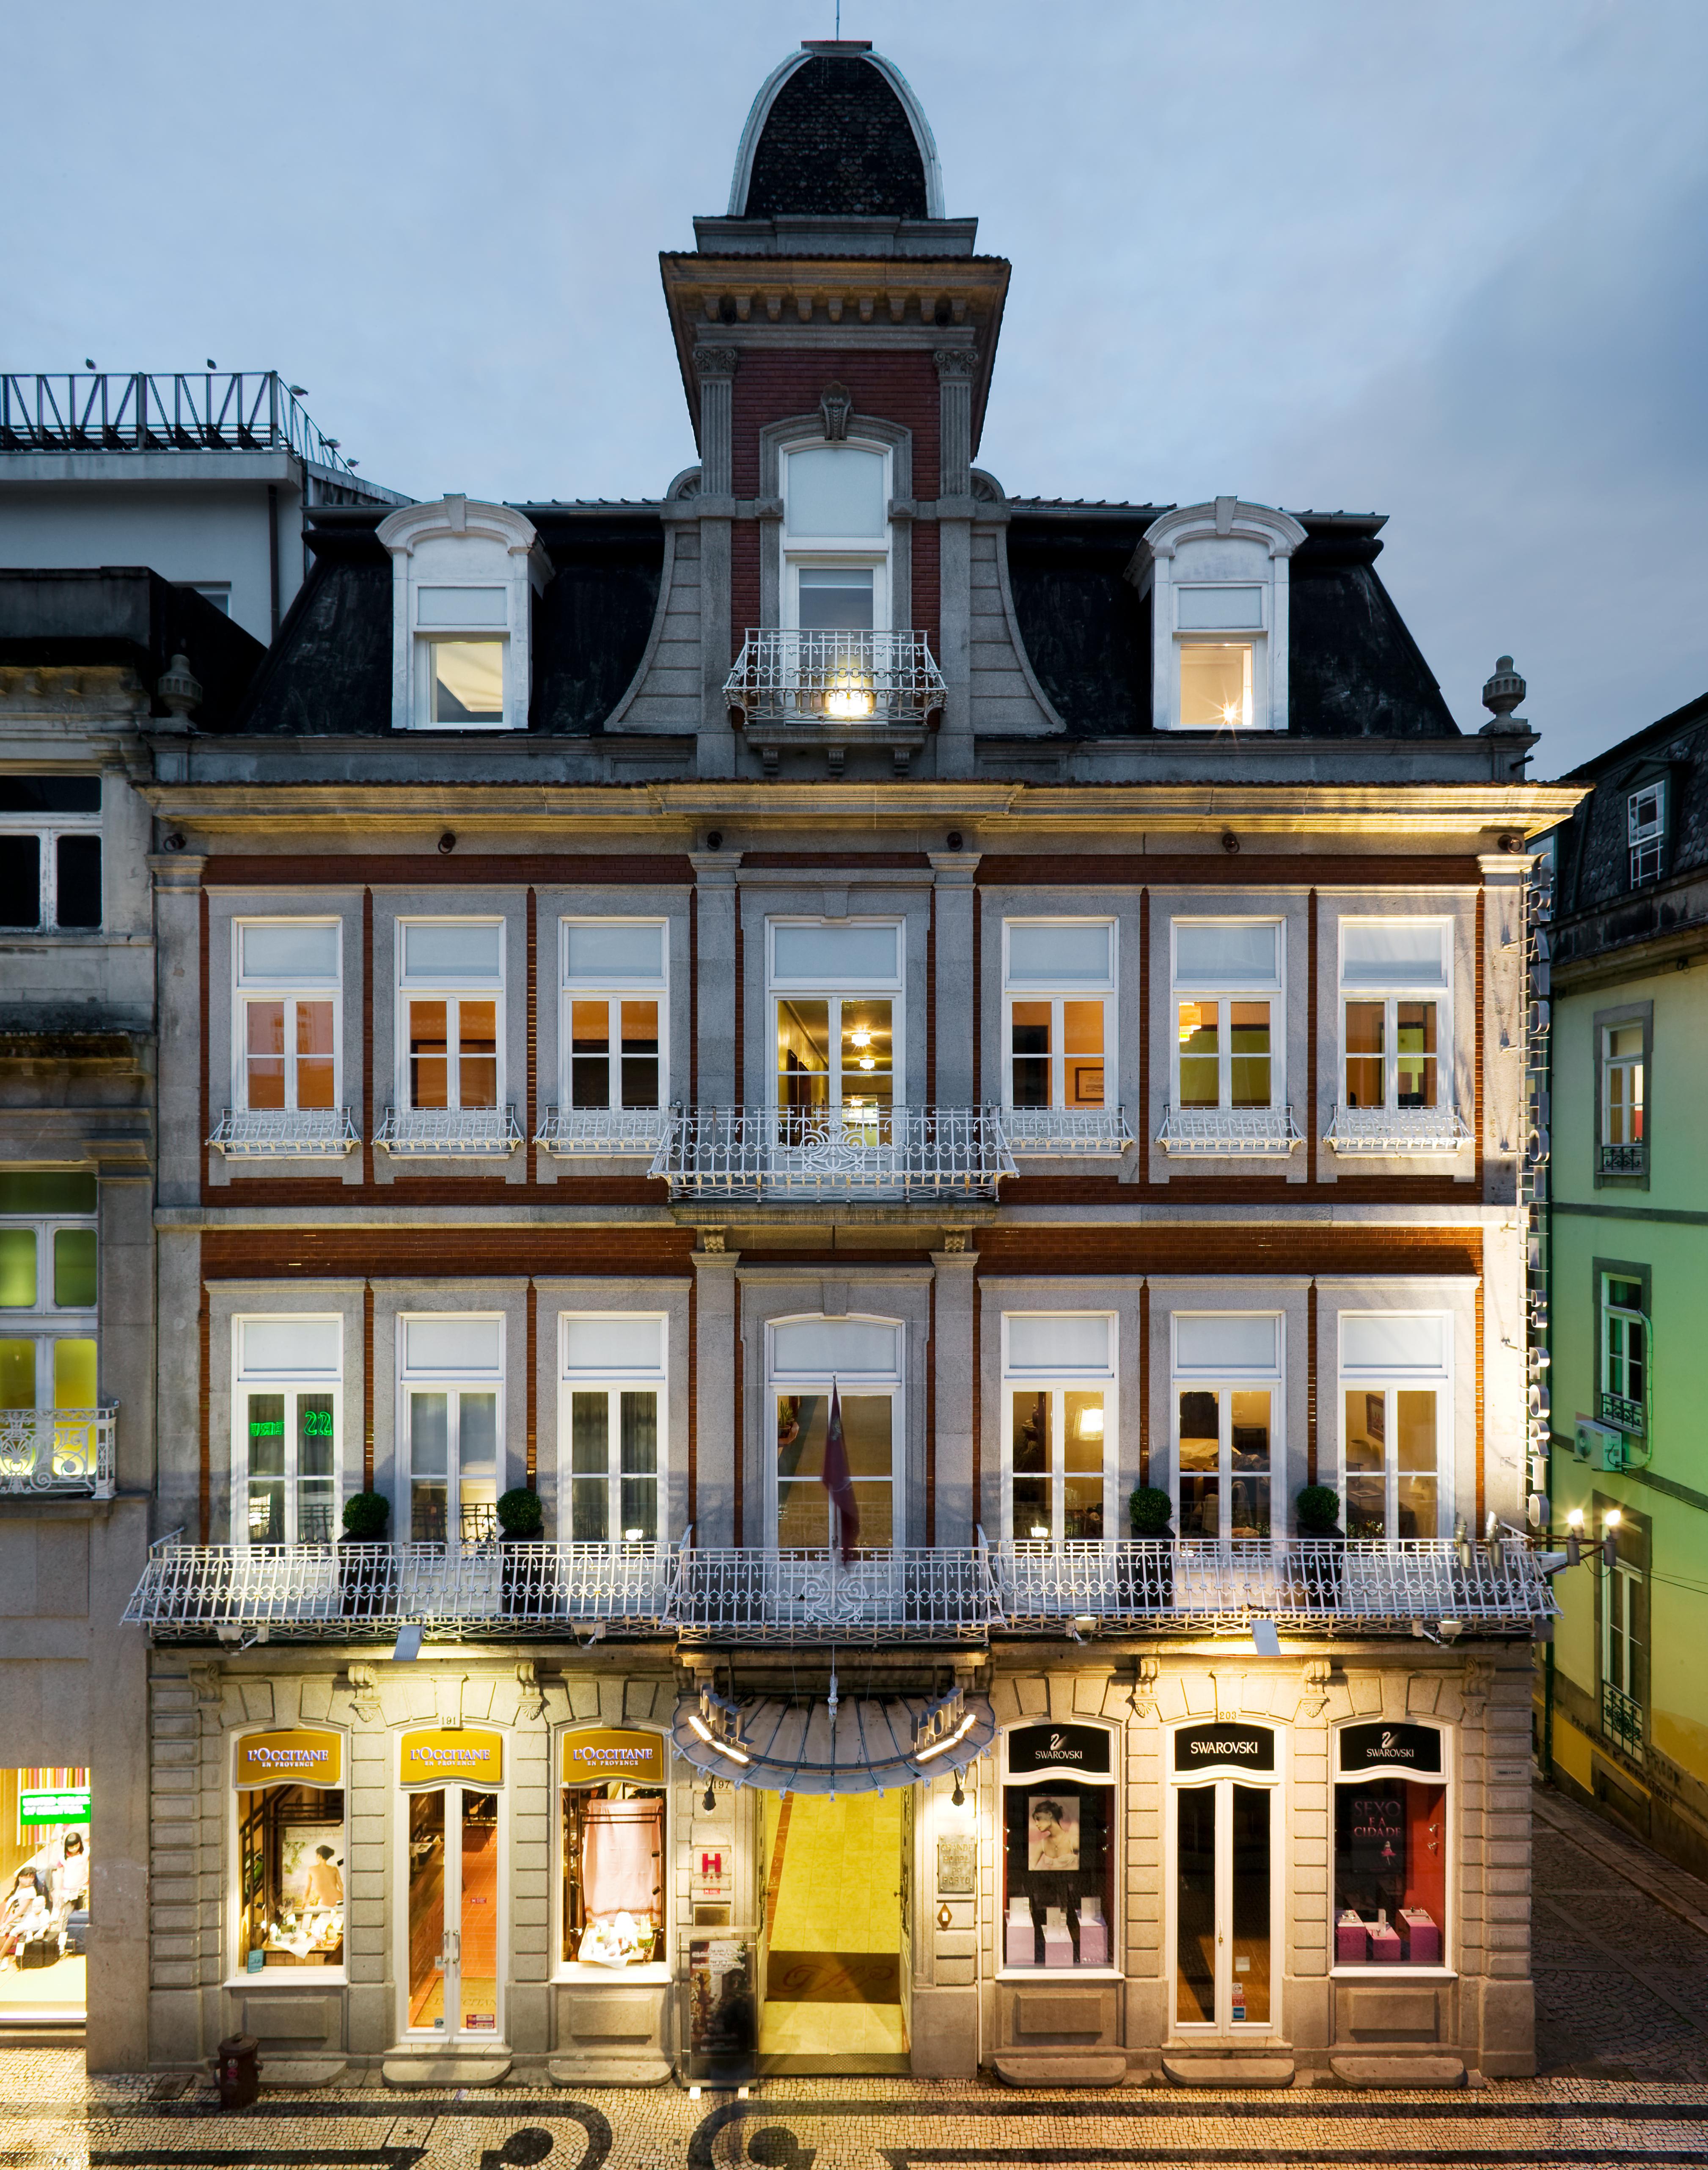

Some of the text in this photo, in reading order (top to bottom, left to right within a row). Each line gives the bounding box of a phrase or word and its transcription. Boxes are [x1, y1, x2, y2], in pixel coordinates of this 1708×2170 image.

[1528, 853, 1551, 1527] GRANDE HOTEL DO PORTO
[699, 1683, 755, 1746] HOTEL
[1219, 1711, 1236, 1719] 203
[1571, 1715, 1608, 1751] PROGRESSO
[410, 1747, 490, 1761] L'OCCITANE
[573, 1747, 653, 1760] L'OCCITANE
[1191, 1741, 1258, 1754] SWAROVSKI
[1367, 1749, 1414, 1757] SWAROVSKI
[248, 1748, 329, 1762] L'OCCITANE
[1035, 1751, 1082, 1759] SWAROVSKI
[1354, 1800, 1401, 1817] SEXO
[1369, 1817, 1386, 1827] E A
[1354, 1826, 1401, 1837] CIDADE
[941, 1843, 973, 1851] GRANDE
[702, 1853, 721, 1873] H
[942, 1875, 971, 1884] PORTO
